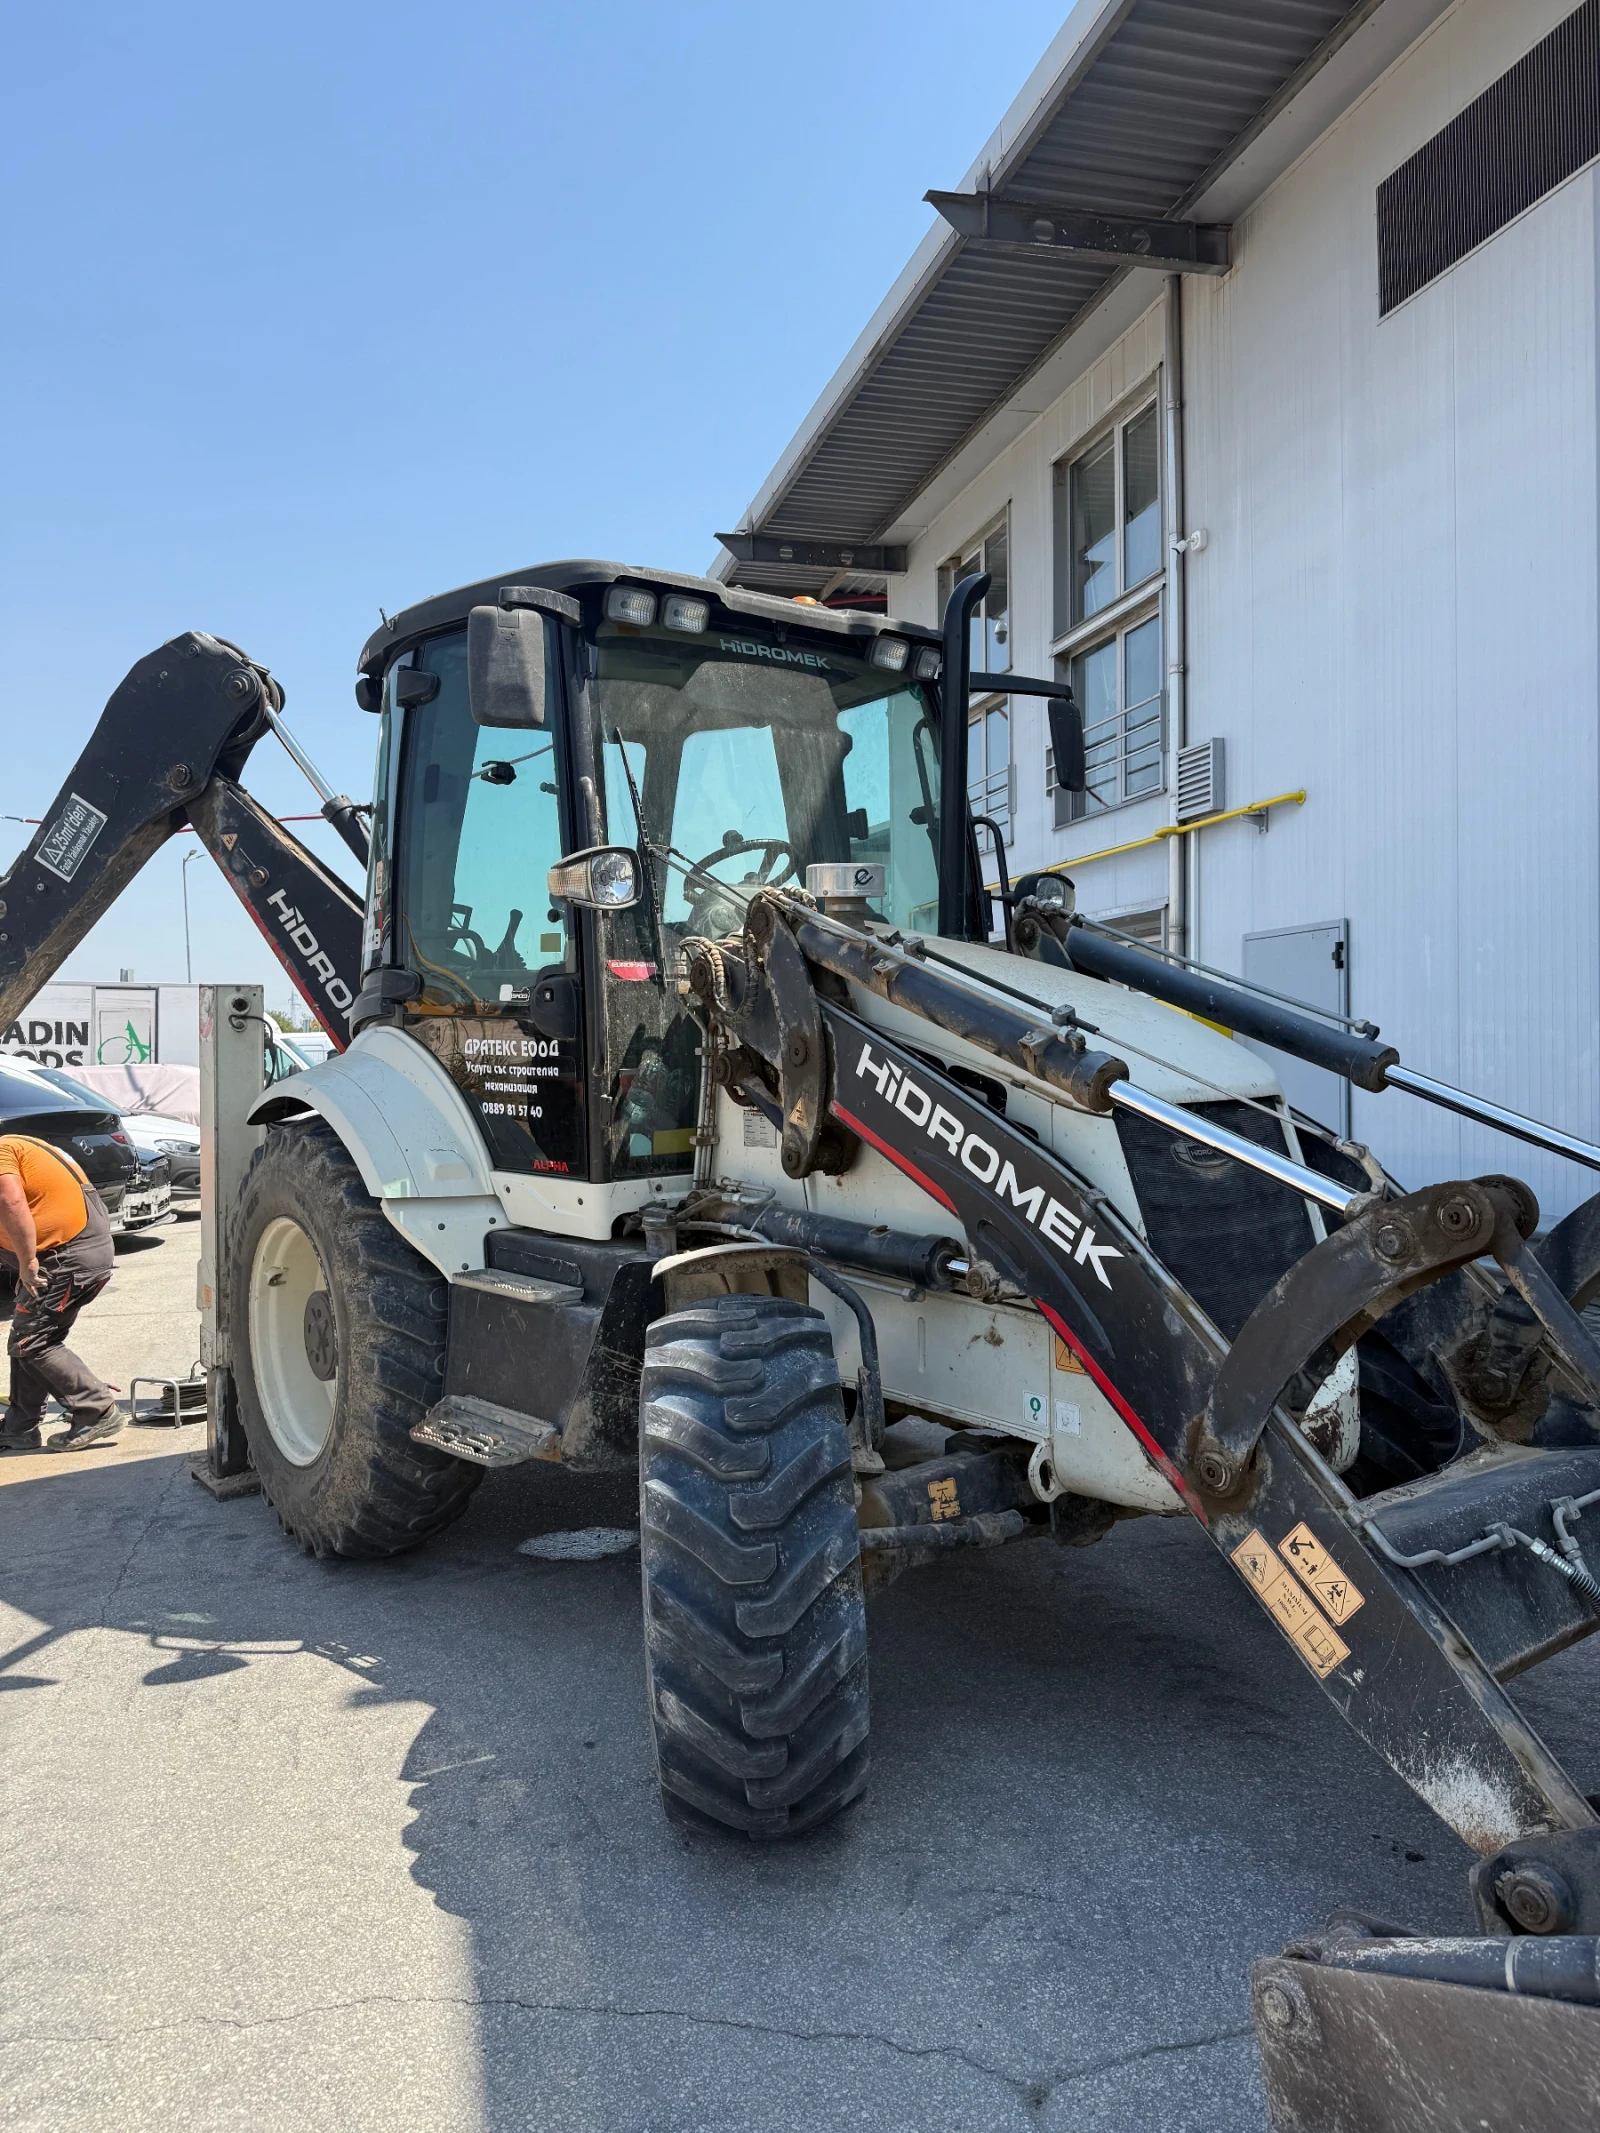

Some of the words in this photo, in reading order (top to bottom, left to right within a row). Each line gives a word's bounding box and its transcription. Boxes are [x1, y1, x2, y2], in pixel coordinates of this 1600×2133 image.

[267, 888, 353, 1020] HiDRO
[0, 1020, 89, 1046] ADIN
[464, 1038, 517, 1057] ДРАТЕКС
[521, 1040, 559, 1057] ЕООД
[465, 1060, 492, 1076] Услуги
[494, 1065, 507, 1074] със
[509, 1065, 559, 1077] строителна
[484, 1081, 538, 1094] механизация
[482, 1102, 505, 1115] 0889
[507, 1103, 516, 1116] 81
[518, 1105, 528, 1117] 57
[530, 1106, 542, 1118] 40
[533, 1159, 569, 1173] ALPHA
[1281, 1580, 1308, 1616] MAXIMUM
